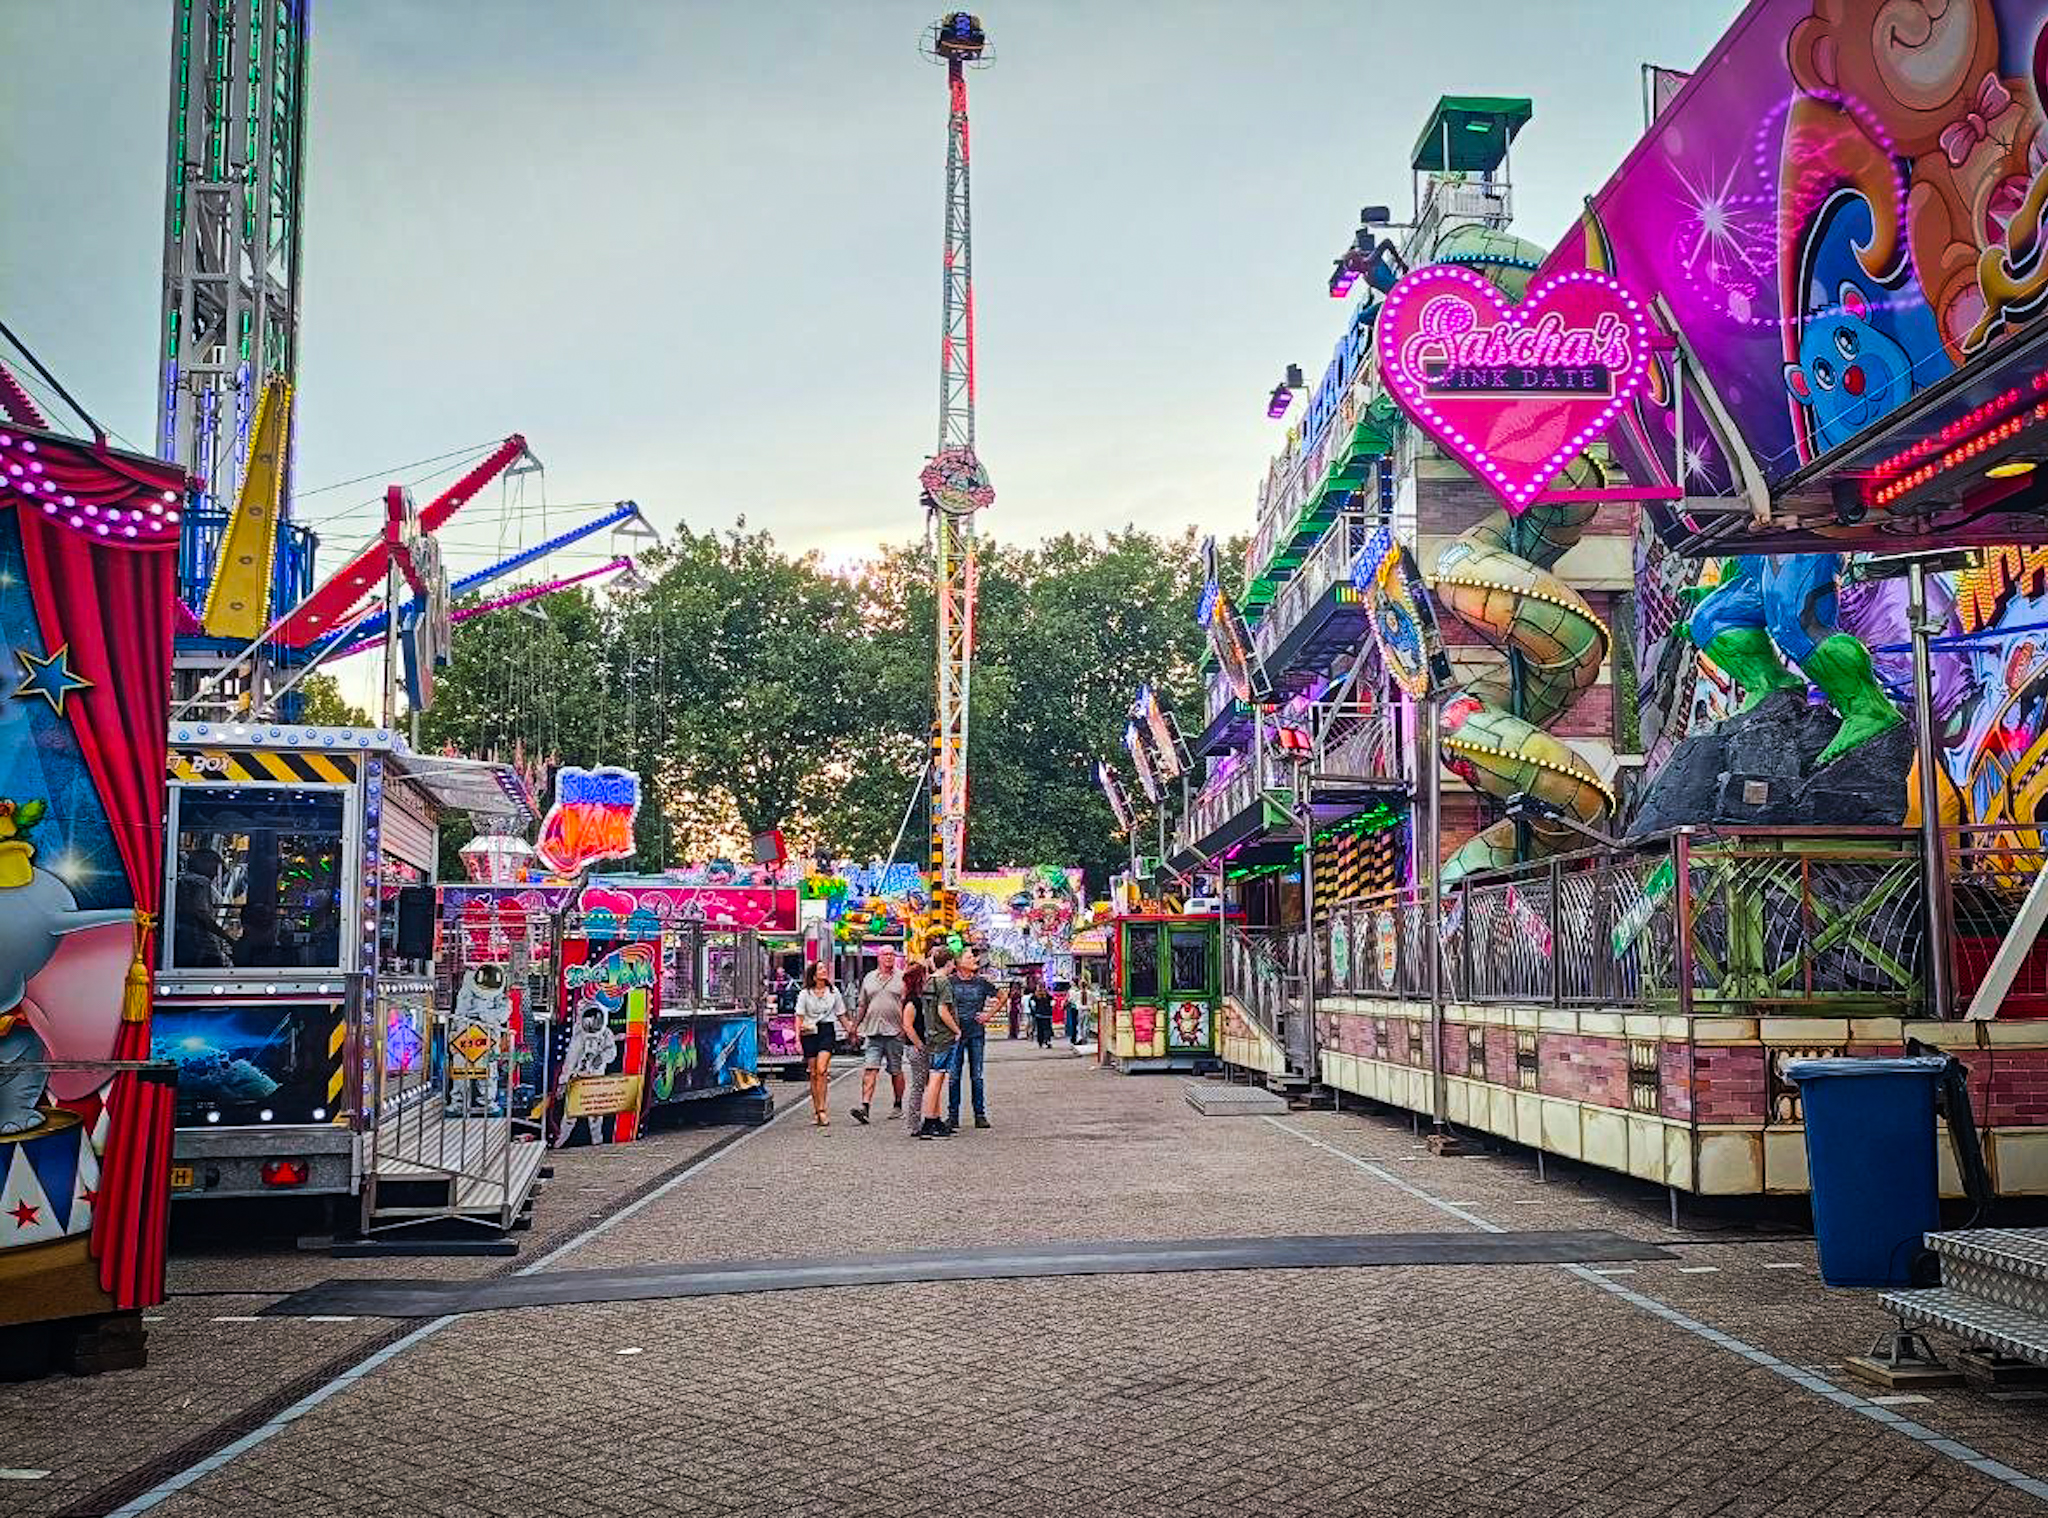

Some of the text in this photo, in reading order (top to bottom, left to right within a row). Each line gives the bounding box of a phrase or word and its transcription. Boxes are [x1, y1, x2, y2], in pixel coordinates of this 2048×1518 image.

[1404, 296, 1628, 386] Sascha's
[1441, 368, 1597, 388] PINK DATE
[190, 755, 231, 772] BOX
[562, 772, 637, 804] SPACE
[541, 805, 634, 868] JAM
